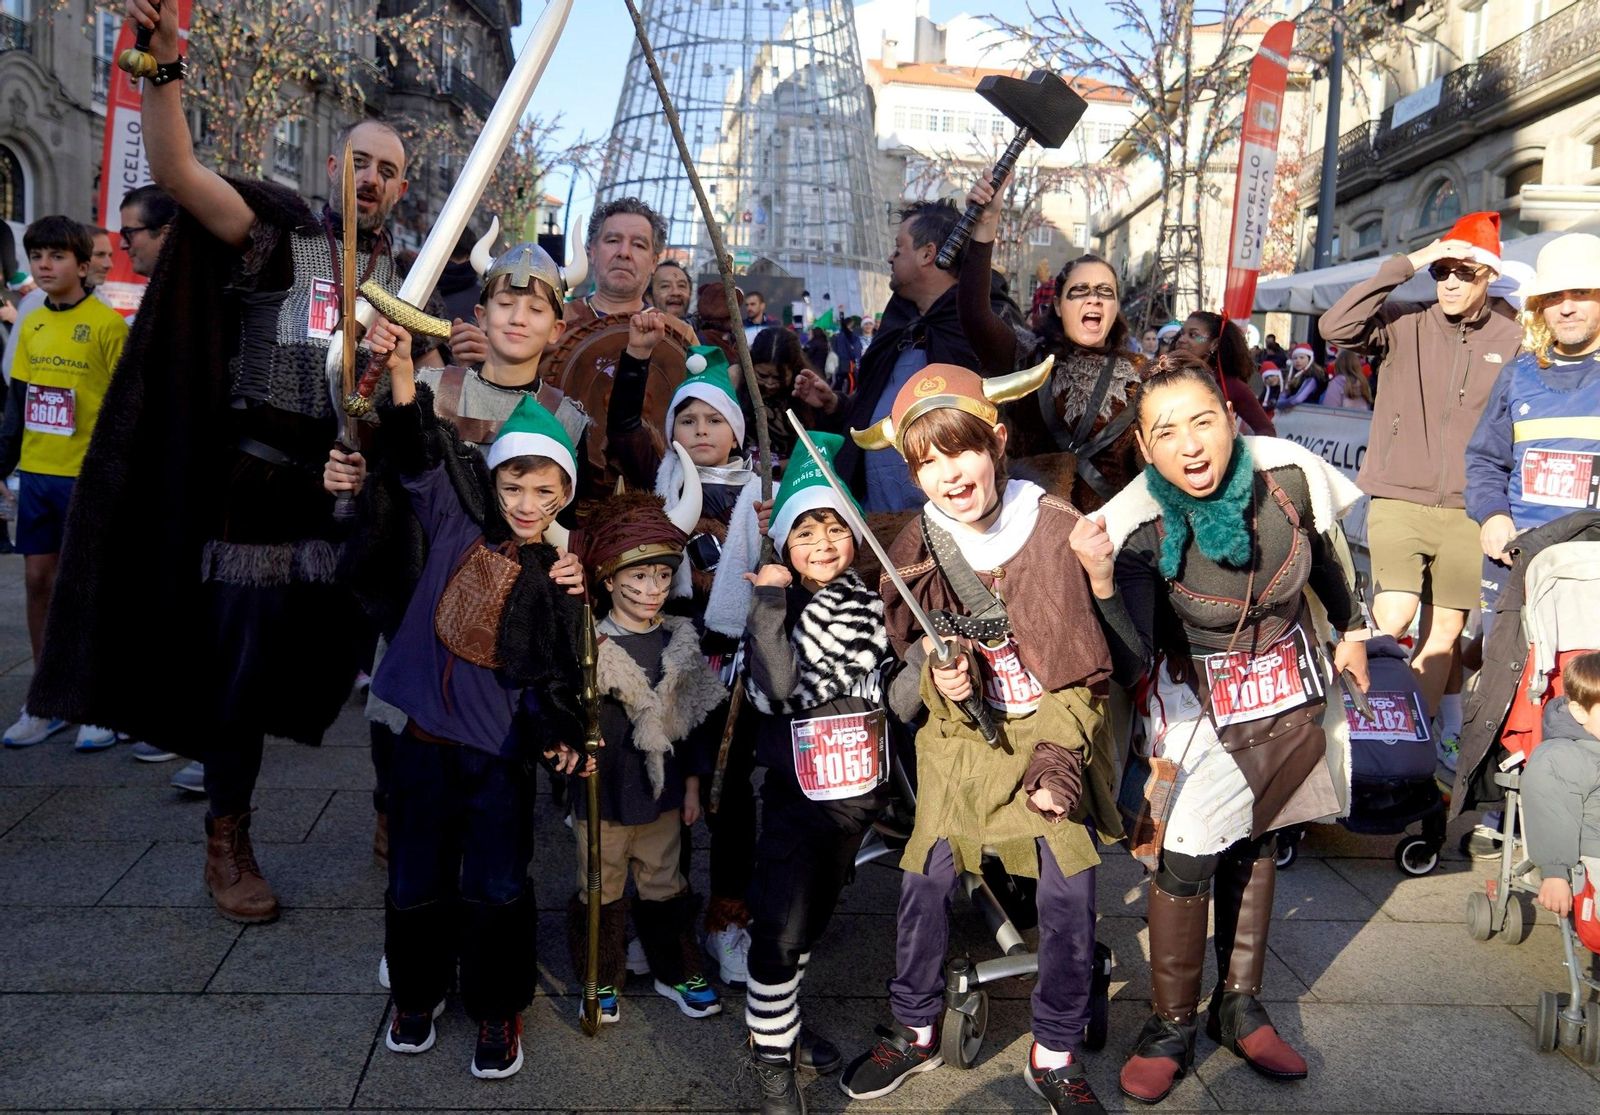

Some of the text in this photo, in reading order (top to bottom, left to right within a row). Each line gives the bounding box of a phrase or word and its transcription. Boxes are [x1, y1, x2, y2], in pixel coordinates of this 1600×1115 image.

[122, 122, 141, 196] NCELLO
[39, 394, 64, 404] vigo
[31, 403, 68, 425] 3604
[1534, 472, 1574, 497] 402
[1237, 656, 1283, 675] vigo
[1227, 668, 1290, 710] 1064
[1354, 710, 1408, 730] 2482
[822, 730, 868, 748] vigo
[814, 746, 872, 786] 1055
